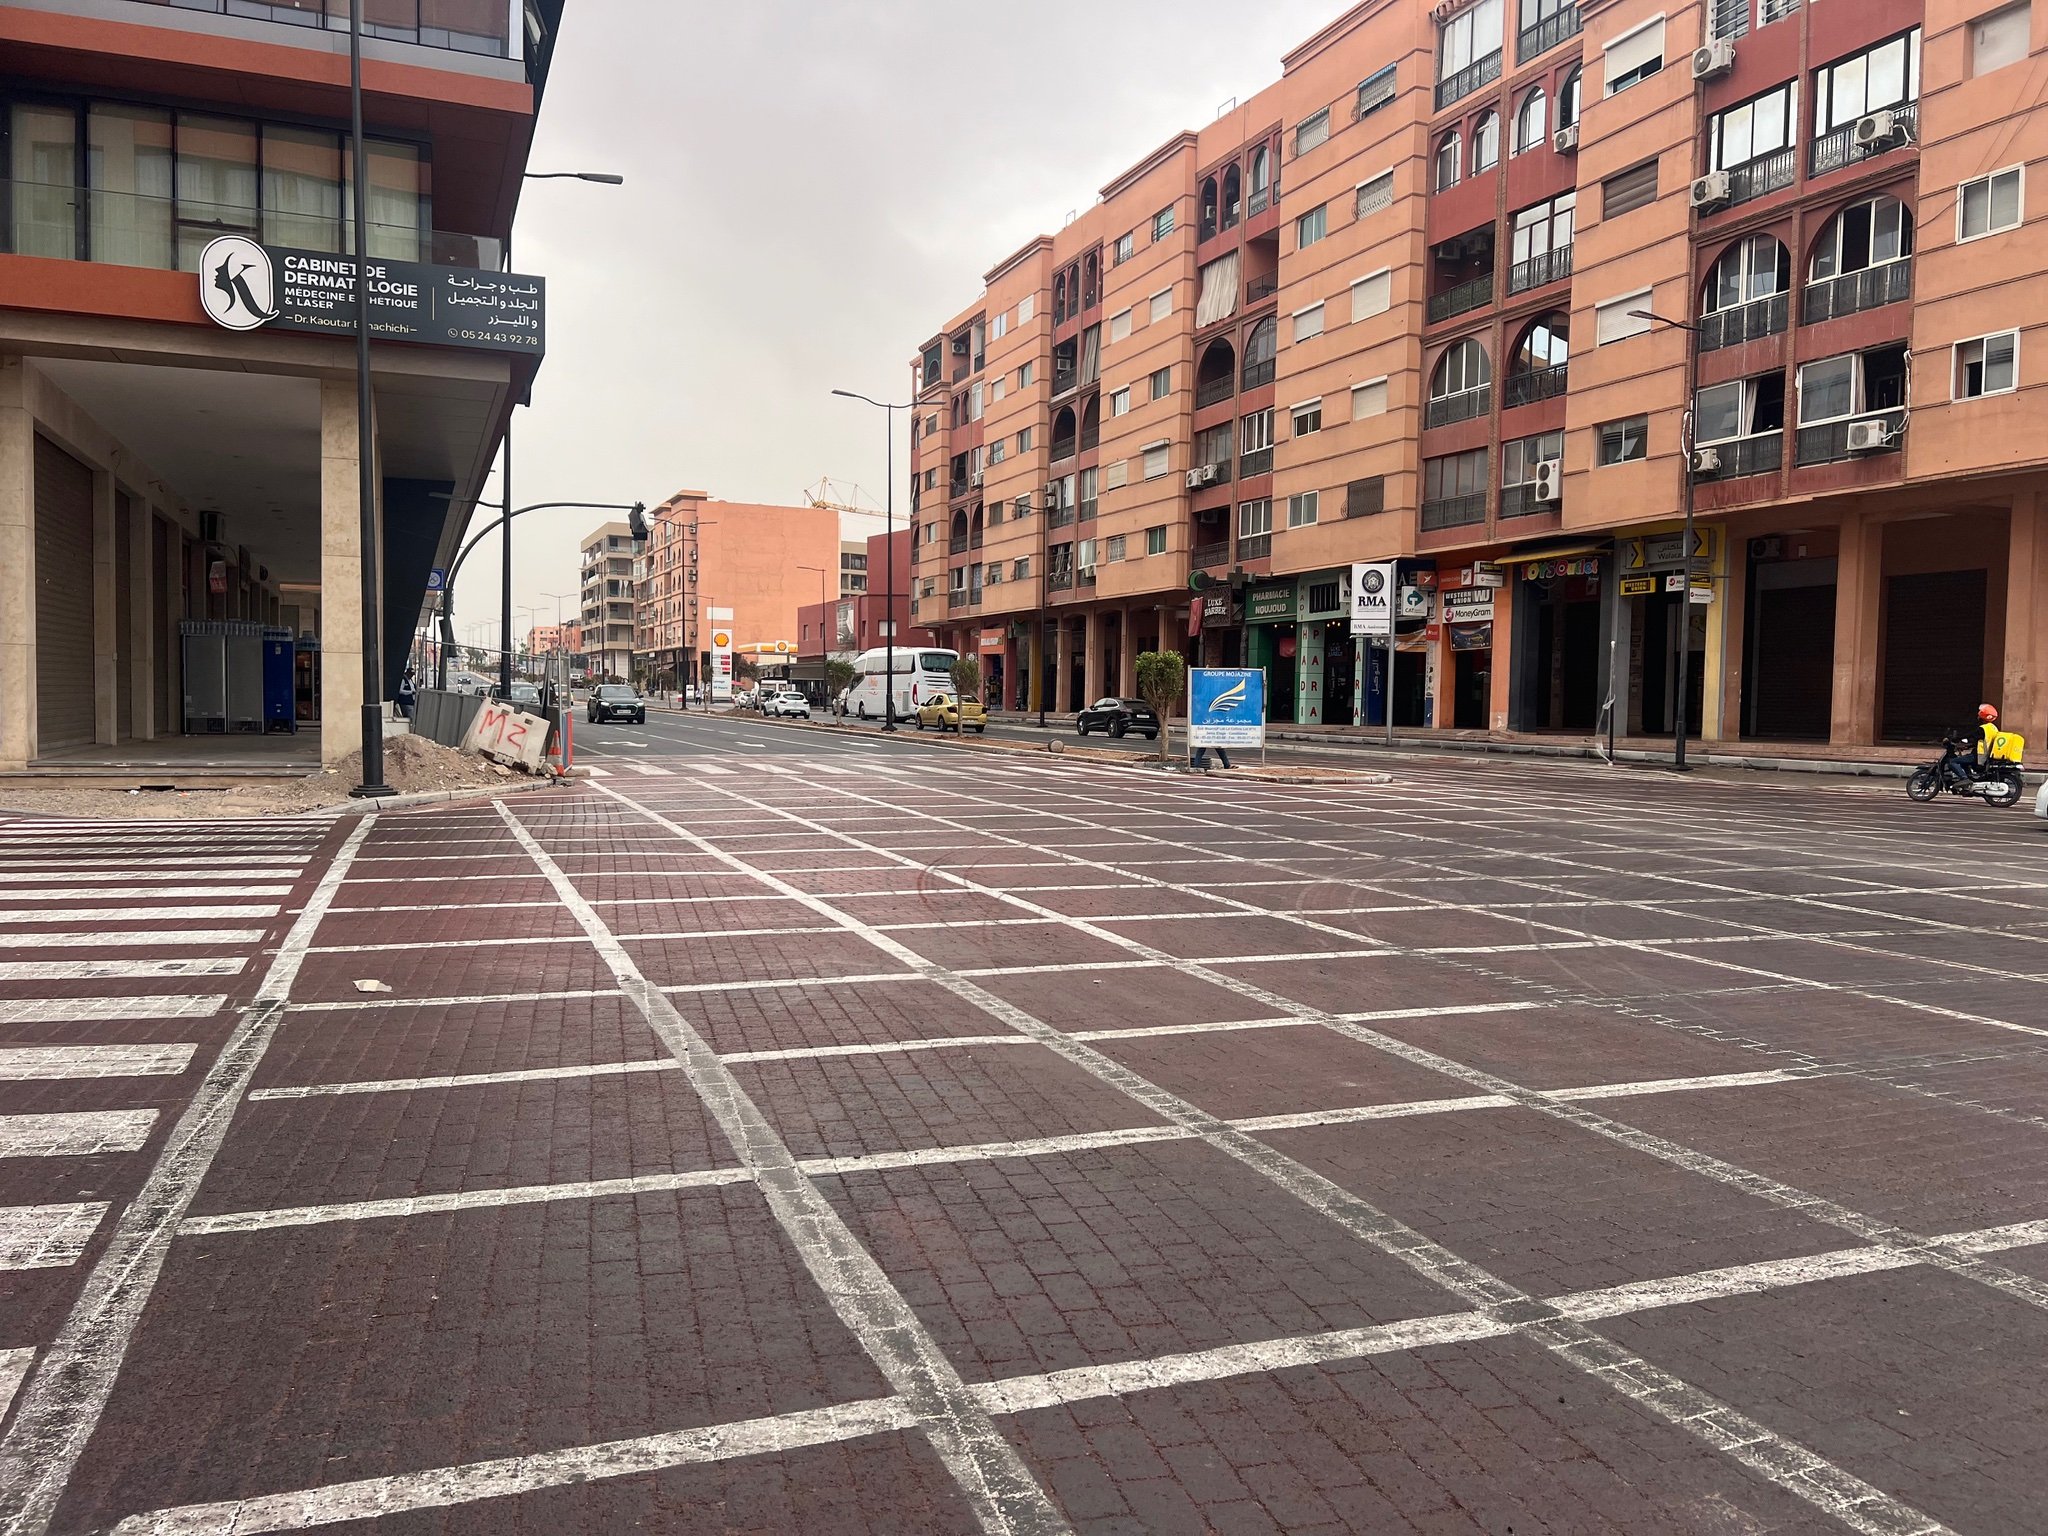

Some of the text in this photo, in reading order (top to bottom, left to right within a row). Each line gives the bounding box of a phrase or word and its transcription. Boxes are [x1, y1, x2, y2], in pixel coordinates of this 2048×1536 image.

[284, 256, 386, 279] CABINET DE
[284, 271, 418, 296] DERMATLOGIE
[447, 274, 538, 294] طب و جراحة
[284, 287, 418, 309] MÉDECINE EHÉTIQUE
[284, 297, 334, 309] & LASER
[447, 292, 538, 311] الجلد و التجميل
[310, 315, 351, 328] Kaoutar
[488, 314, 538, 329] و الليزر
[461, 329, 538, 345] 05 24 43 92 78
[1252, 590, 1290, 601] PHARMACIE
[1357, 596, 1386, 607] RMA
[1445, 591, 1472, 599] WESTERN
[1207, 598, 1223, 607] LUXE
[1255, 604, 1287, 614] NOUJOUD
[1204, 607, 1226, 617] BARBER
[1455, 608, 1491, 618] MoneyGram
[1309, 629, 1320, 717] PARA
